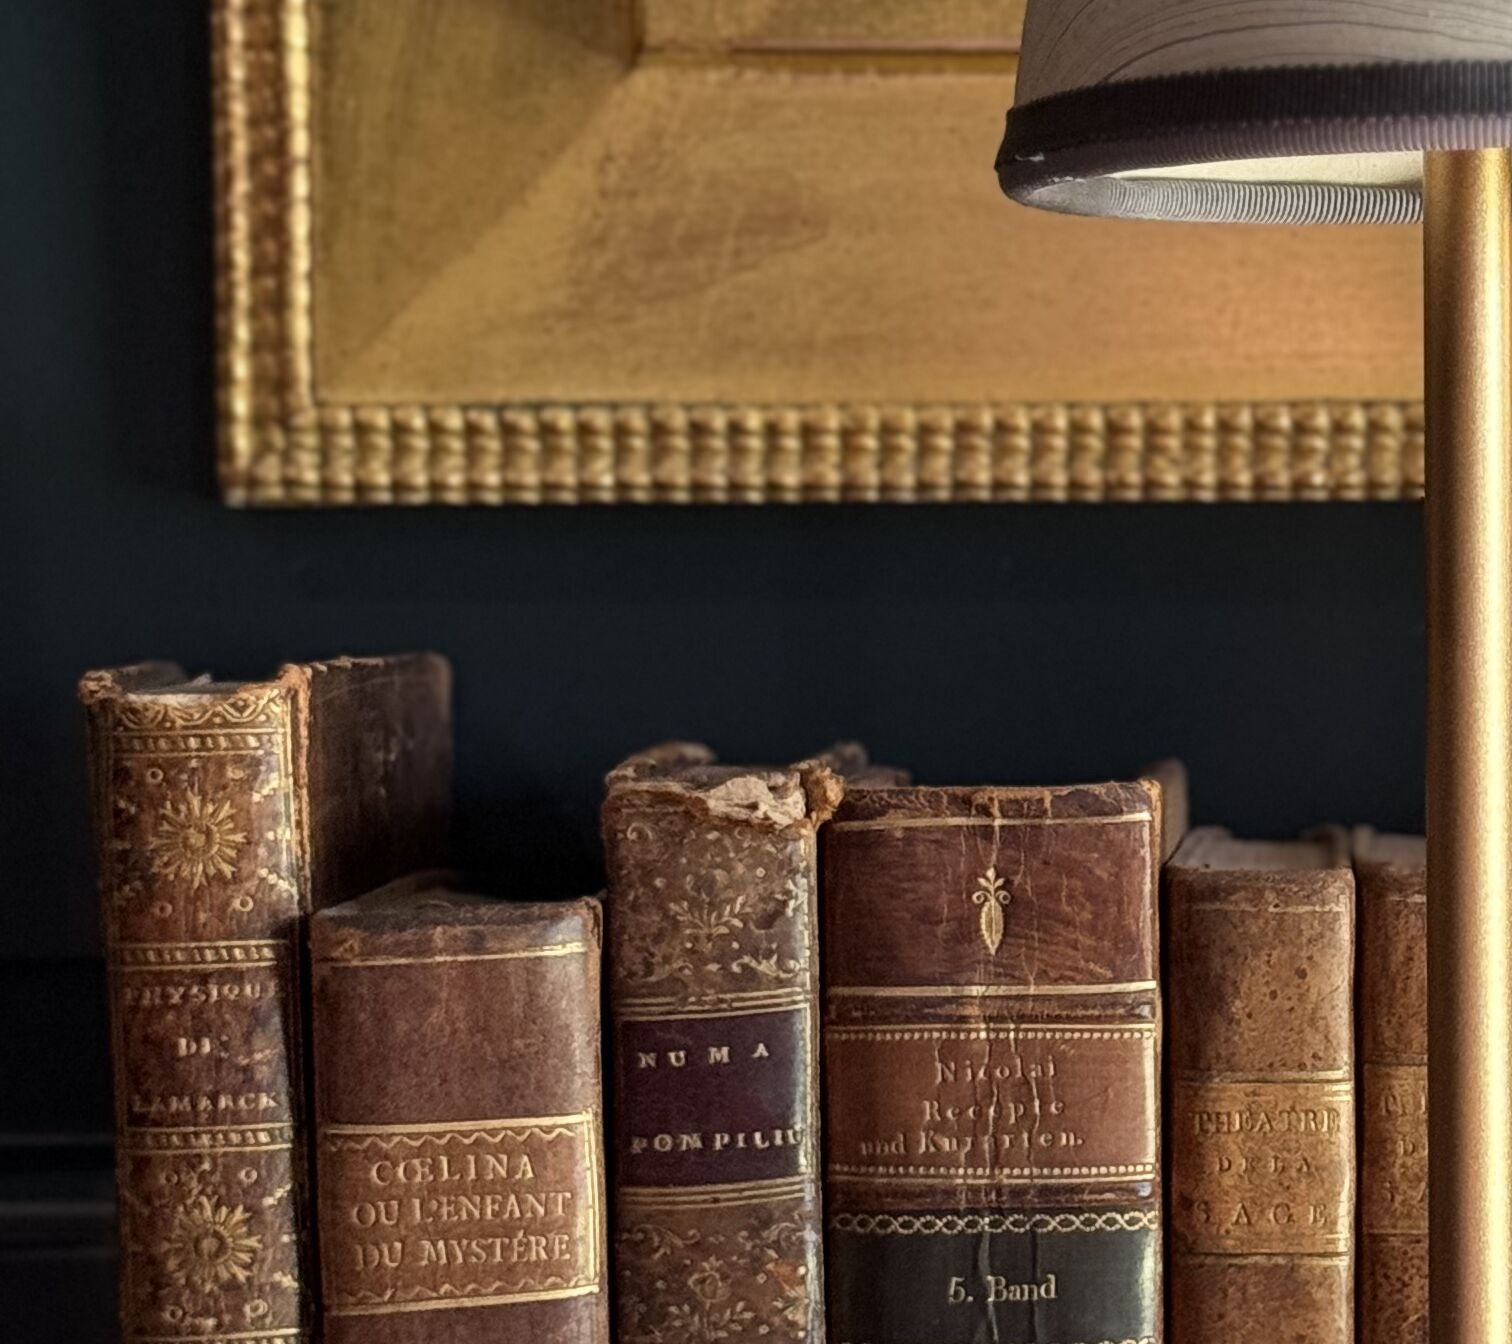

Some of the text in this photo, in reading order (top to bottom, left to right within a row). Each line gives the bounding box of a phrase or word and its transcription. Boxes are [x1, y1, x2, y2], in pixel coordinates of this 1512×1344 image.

[637, 1042, 770, 1069] NUMA
[933, 1055, 1056, 1085] Nicolai
[1189, 1107, 1341, 1136] THEATRE
[859, 1132, 907, 1156] und
[353, 1199, 399, 1228] OU
[1193, 1201, 1328, 1227] SAGE
[354, 1241, 402, 1271] DU
[948, 1273, 1059, 1303] 5. Band
